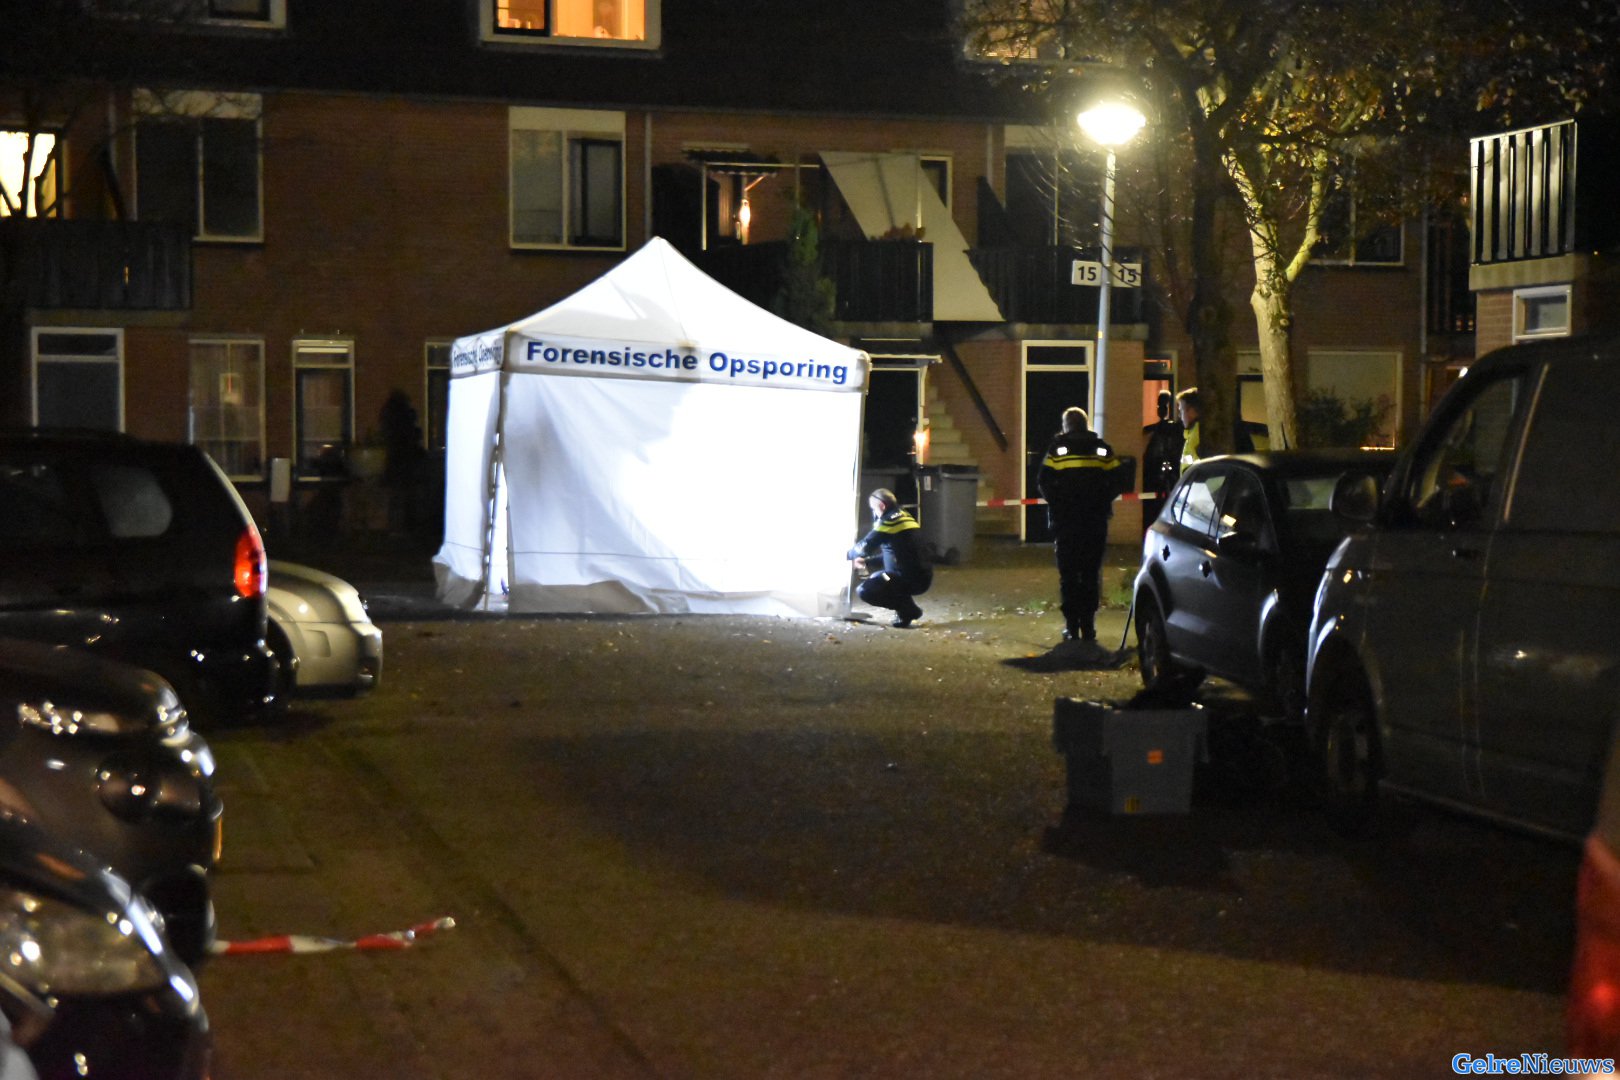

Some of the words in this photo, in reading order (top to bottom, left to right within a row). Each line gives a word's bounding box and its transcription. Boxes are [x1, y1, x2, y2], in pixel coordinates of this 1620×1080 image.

[1077, 266, 1097, 282] 15
[1118, 268, 1137, 283] 15
[526, 341, 699, 370] Forensische
[708, 352, 849, 385] Opsporing
